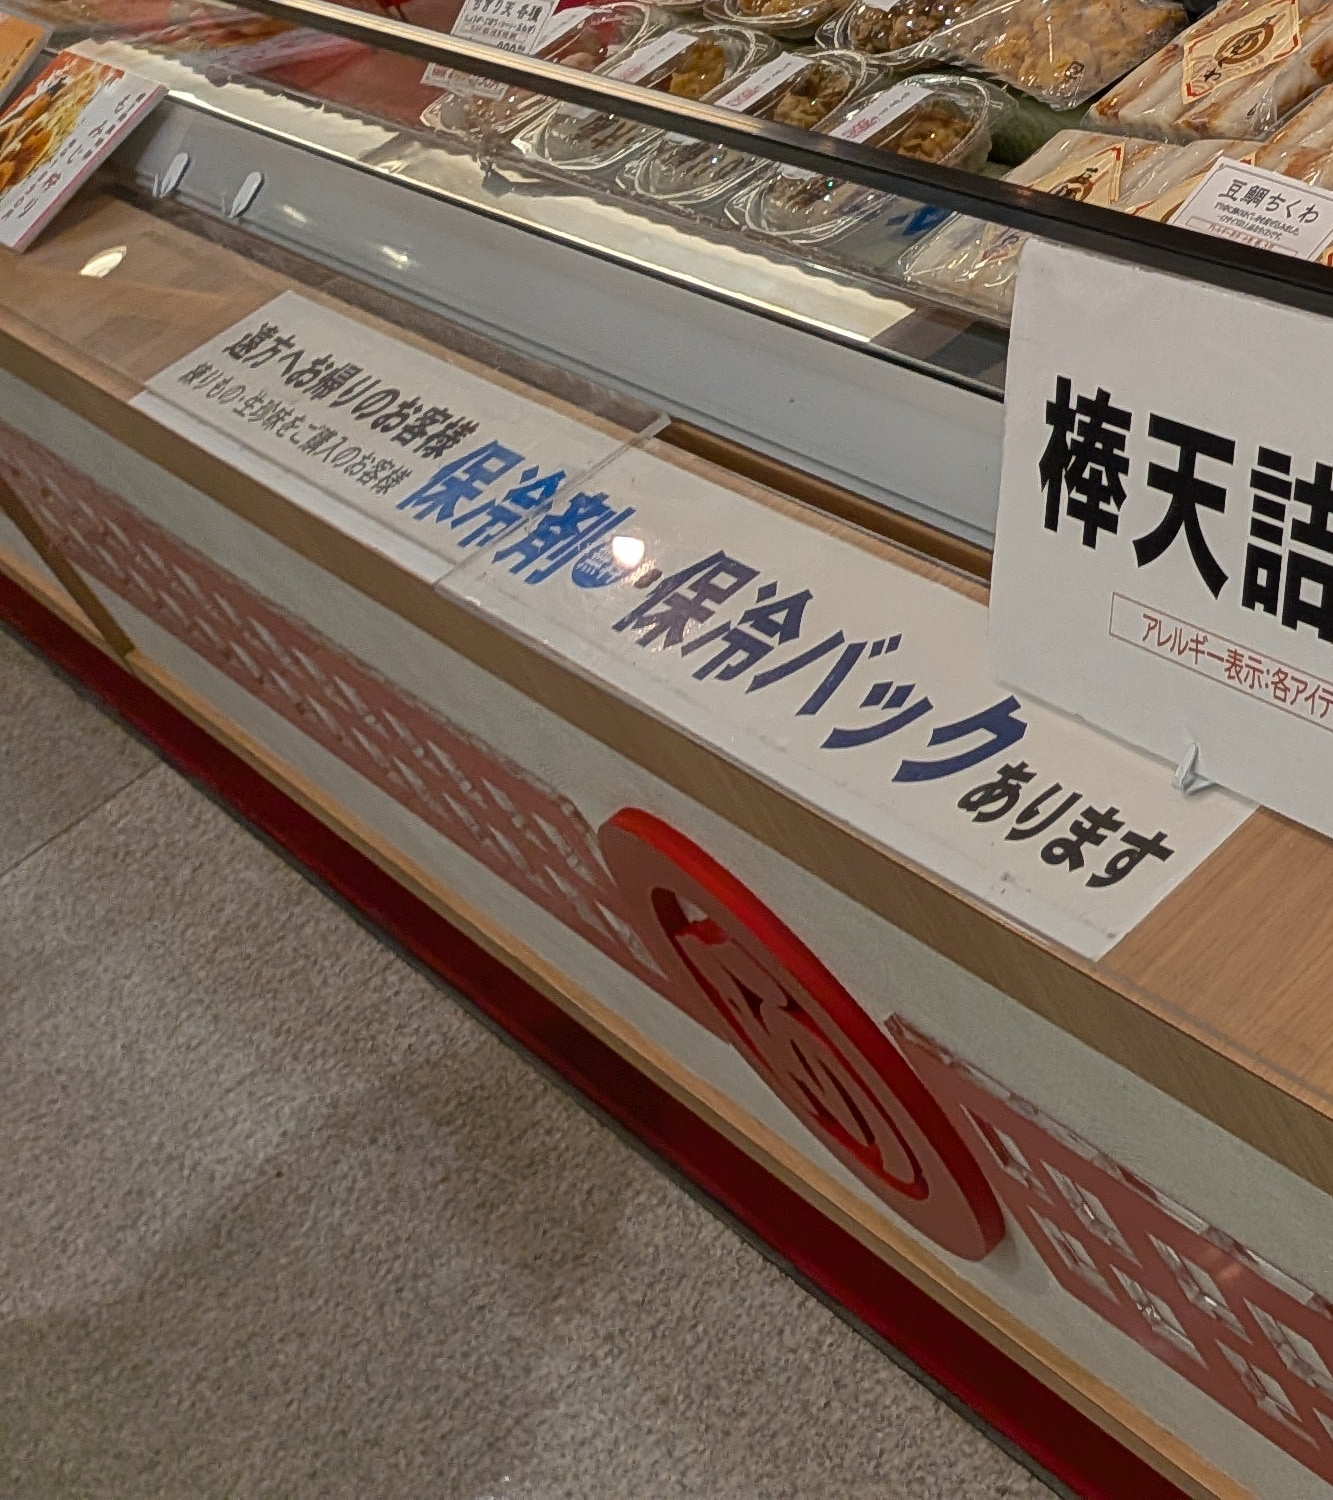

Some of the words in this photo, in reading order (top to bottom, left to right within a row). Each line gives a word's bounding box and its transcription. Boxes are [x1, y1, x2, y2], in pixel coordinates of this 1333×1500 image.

[1217, 178, 1320, 225] 豆鯛ちくわ
[396, 440, 637, 584] 保冷剤
[956, 758, 1176, 891] あります
